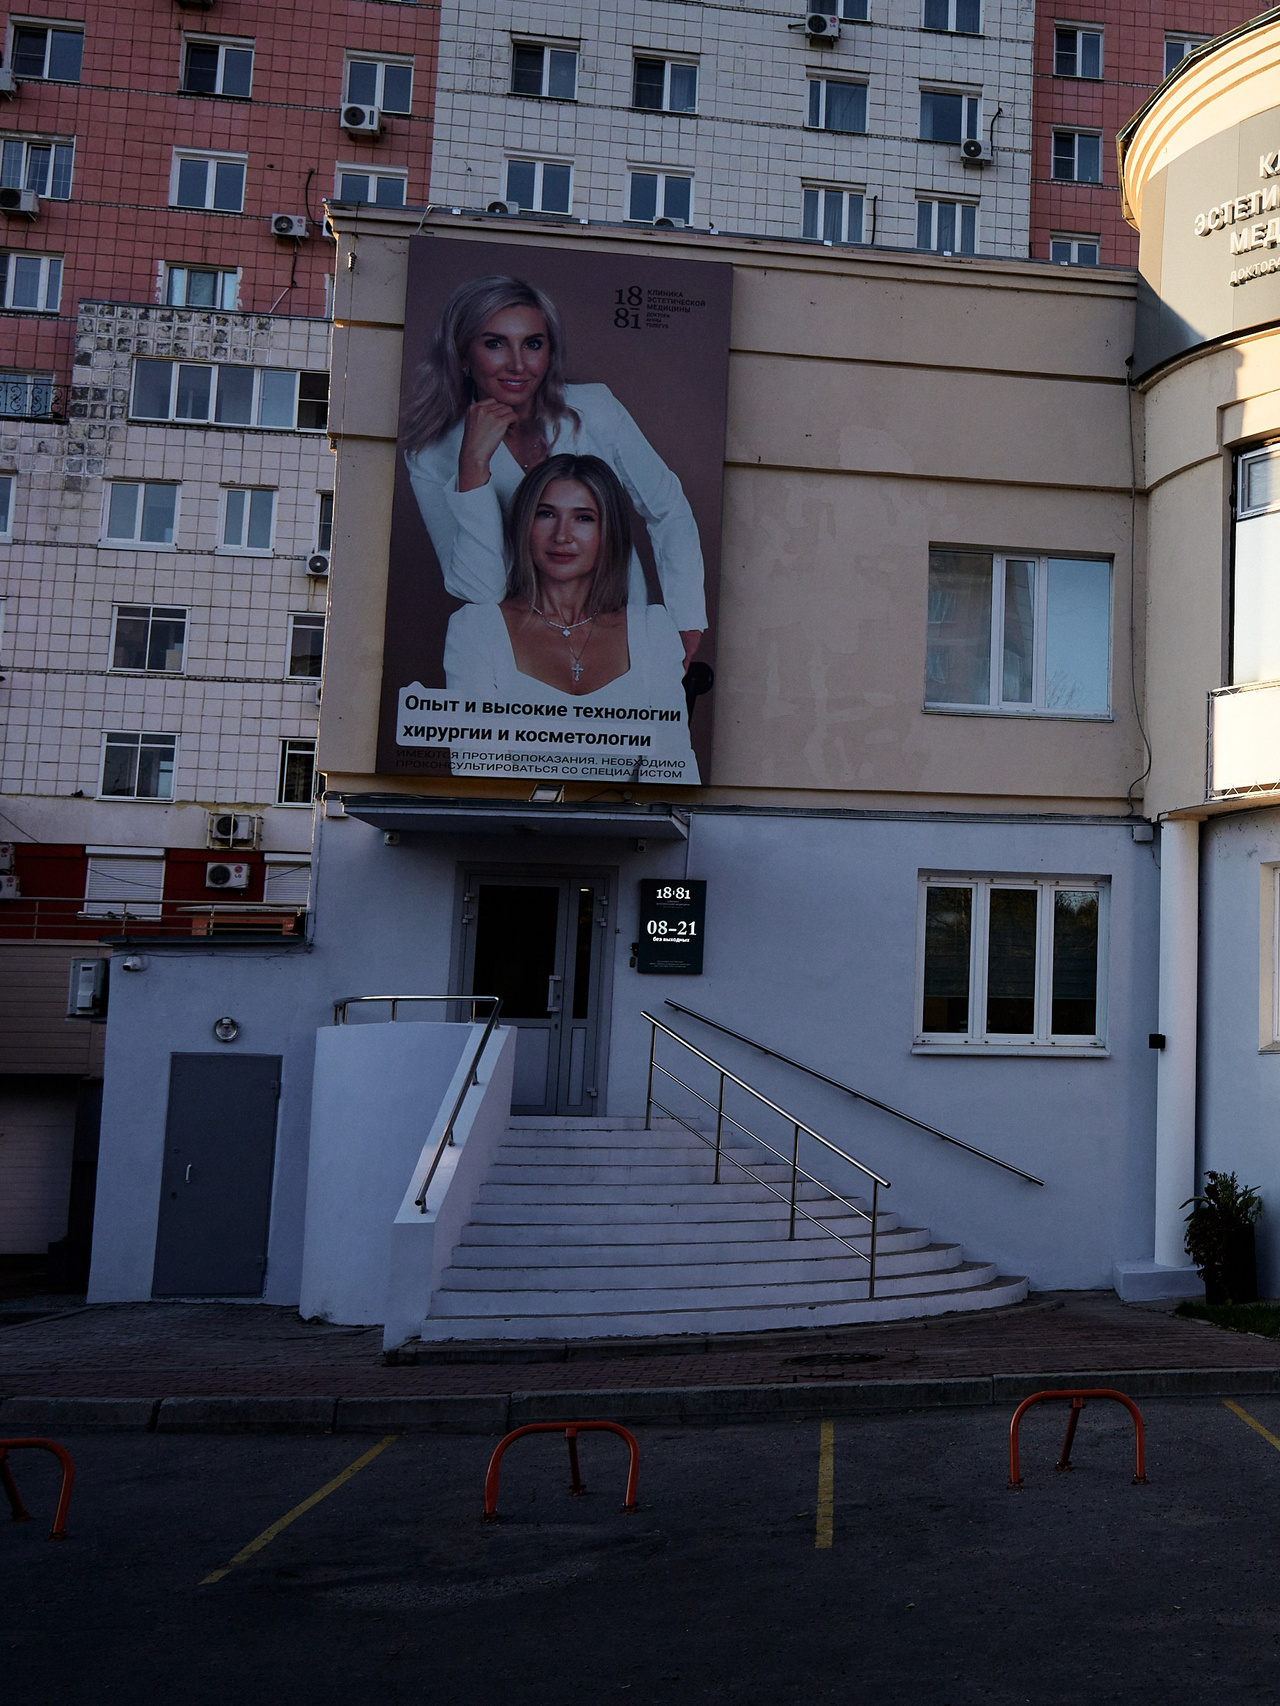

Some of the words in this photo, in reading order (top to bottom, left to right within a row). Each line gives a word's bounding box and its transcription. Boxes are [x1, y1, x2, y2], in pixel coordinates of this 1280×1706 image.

[615, 285, 643, 307] 18
[647, 289, 684, 298] КЛИНИКА
[647, 296, 706, 307] ЭСТЕТИЧЕСКОЙ
[613, 307, 642, 330] 81
[646, 304, 691, 313] МЕДИЦИНЫ
[404, 694, 460, 713] Опыт
[464, 700, 477, 713] и
[482, 701, 568, 718] высокие
[573, 703, 682, 722] технологии
[402, 724, 492, 743] хирургии
[498, 729, 510, 742] и
[515, 727, 652, 747] косметологии
[395, 759, 559, 774] ПРОКОНСУЛЬТИРОВАТЬСЯ
[561, 766, 579, 775] СО
[581, 767, 683, 779] СПЕЦИАЛИСТОМ
[396, 750, 459, 760] ИМЕЮТСЯ
[461, 751, 599, 766] ПРОТИВОПОКАЗАНИЯ.
[601, 757, 687, 769] НЕОБХОДИМО
